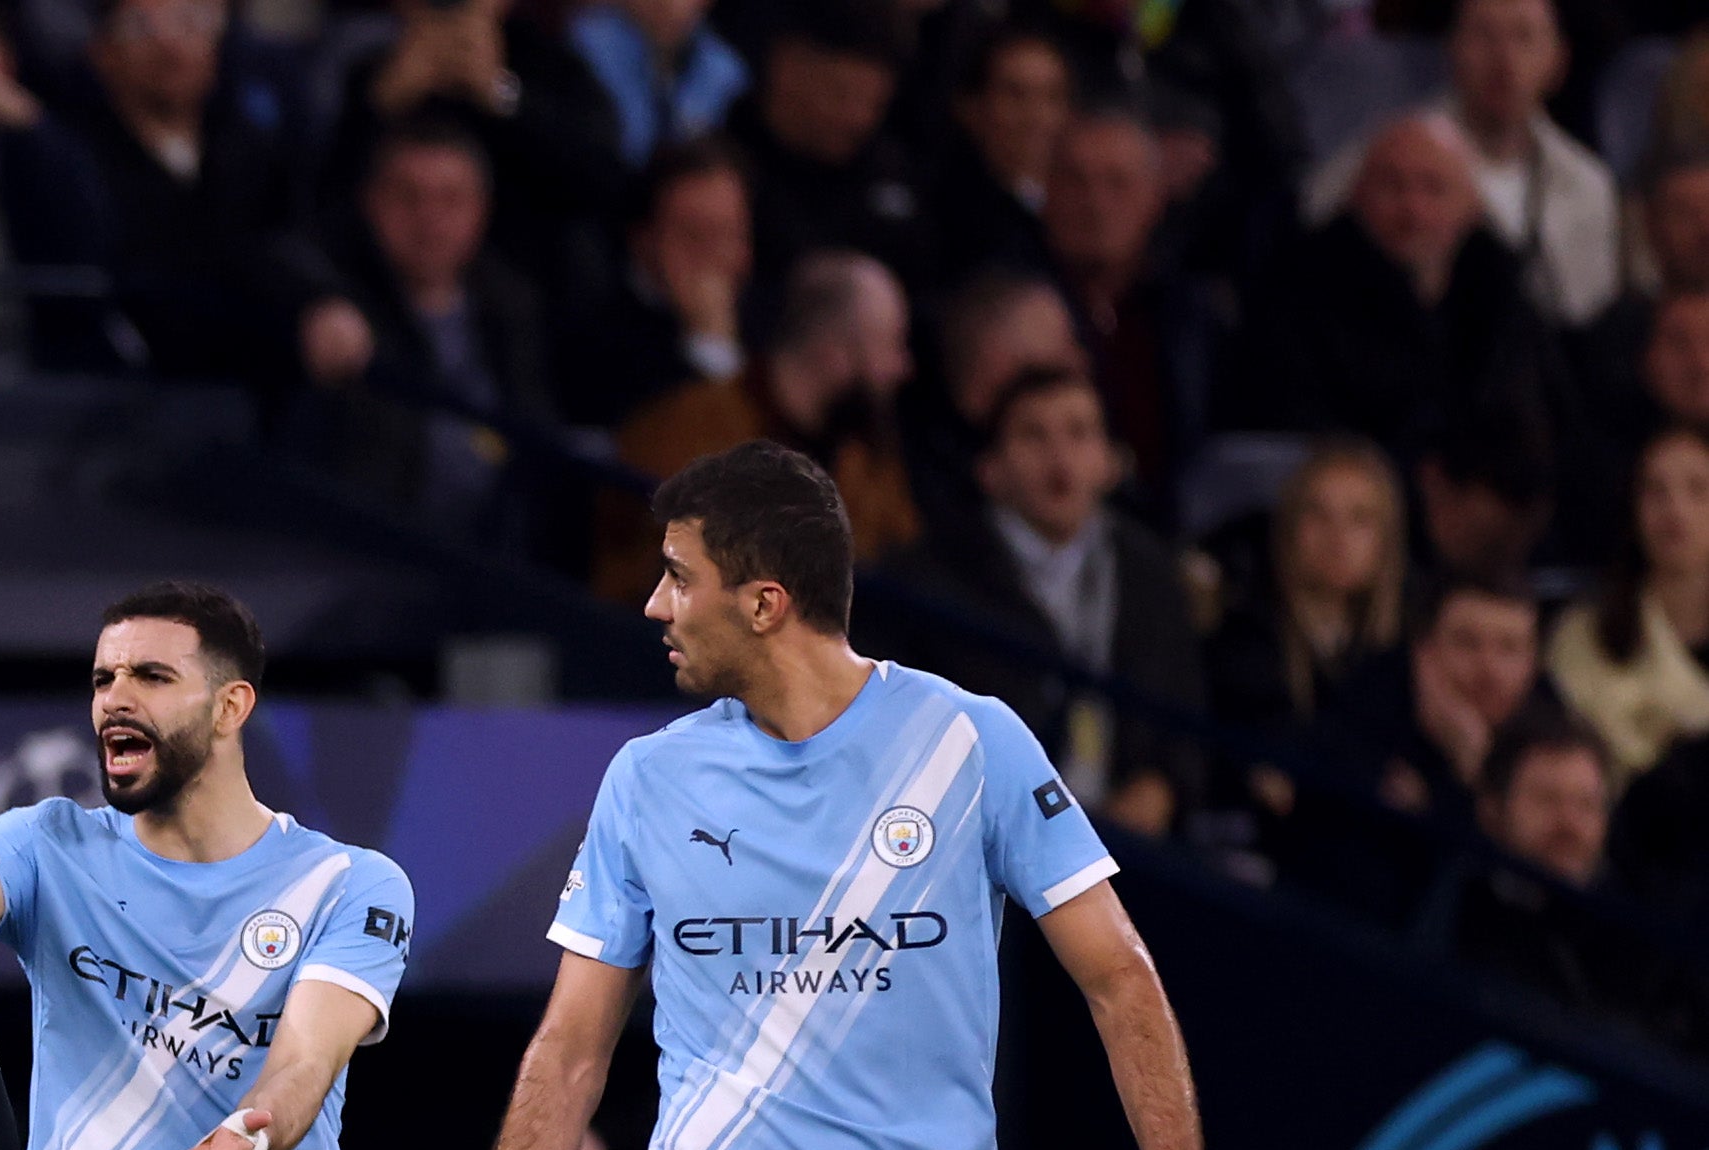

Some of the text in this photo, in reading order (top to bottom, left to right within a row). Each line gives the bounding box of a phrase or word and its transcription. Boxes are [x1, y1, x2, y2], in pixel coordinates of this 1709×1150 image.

[878, 810, 928, 831] MANCHESTER
[247, 915, 295, 933] MANCHESTER
[673, 911, 948, 956] ETIHAD
[729, 967, 892, 995] AIRWAYS
